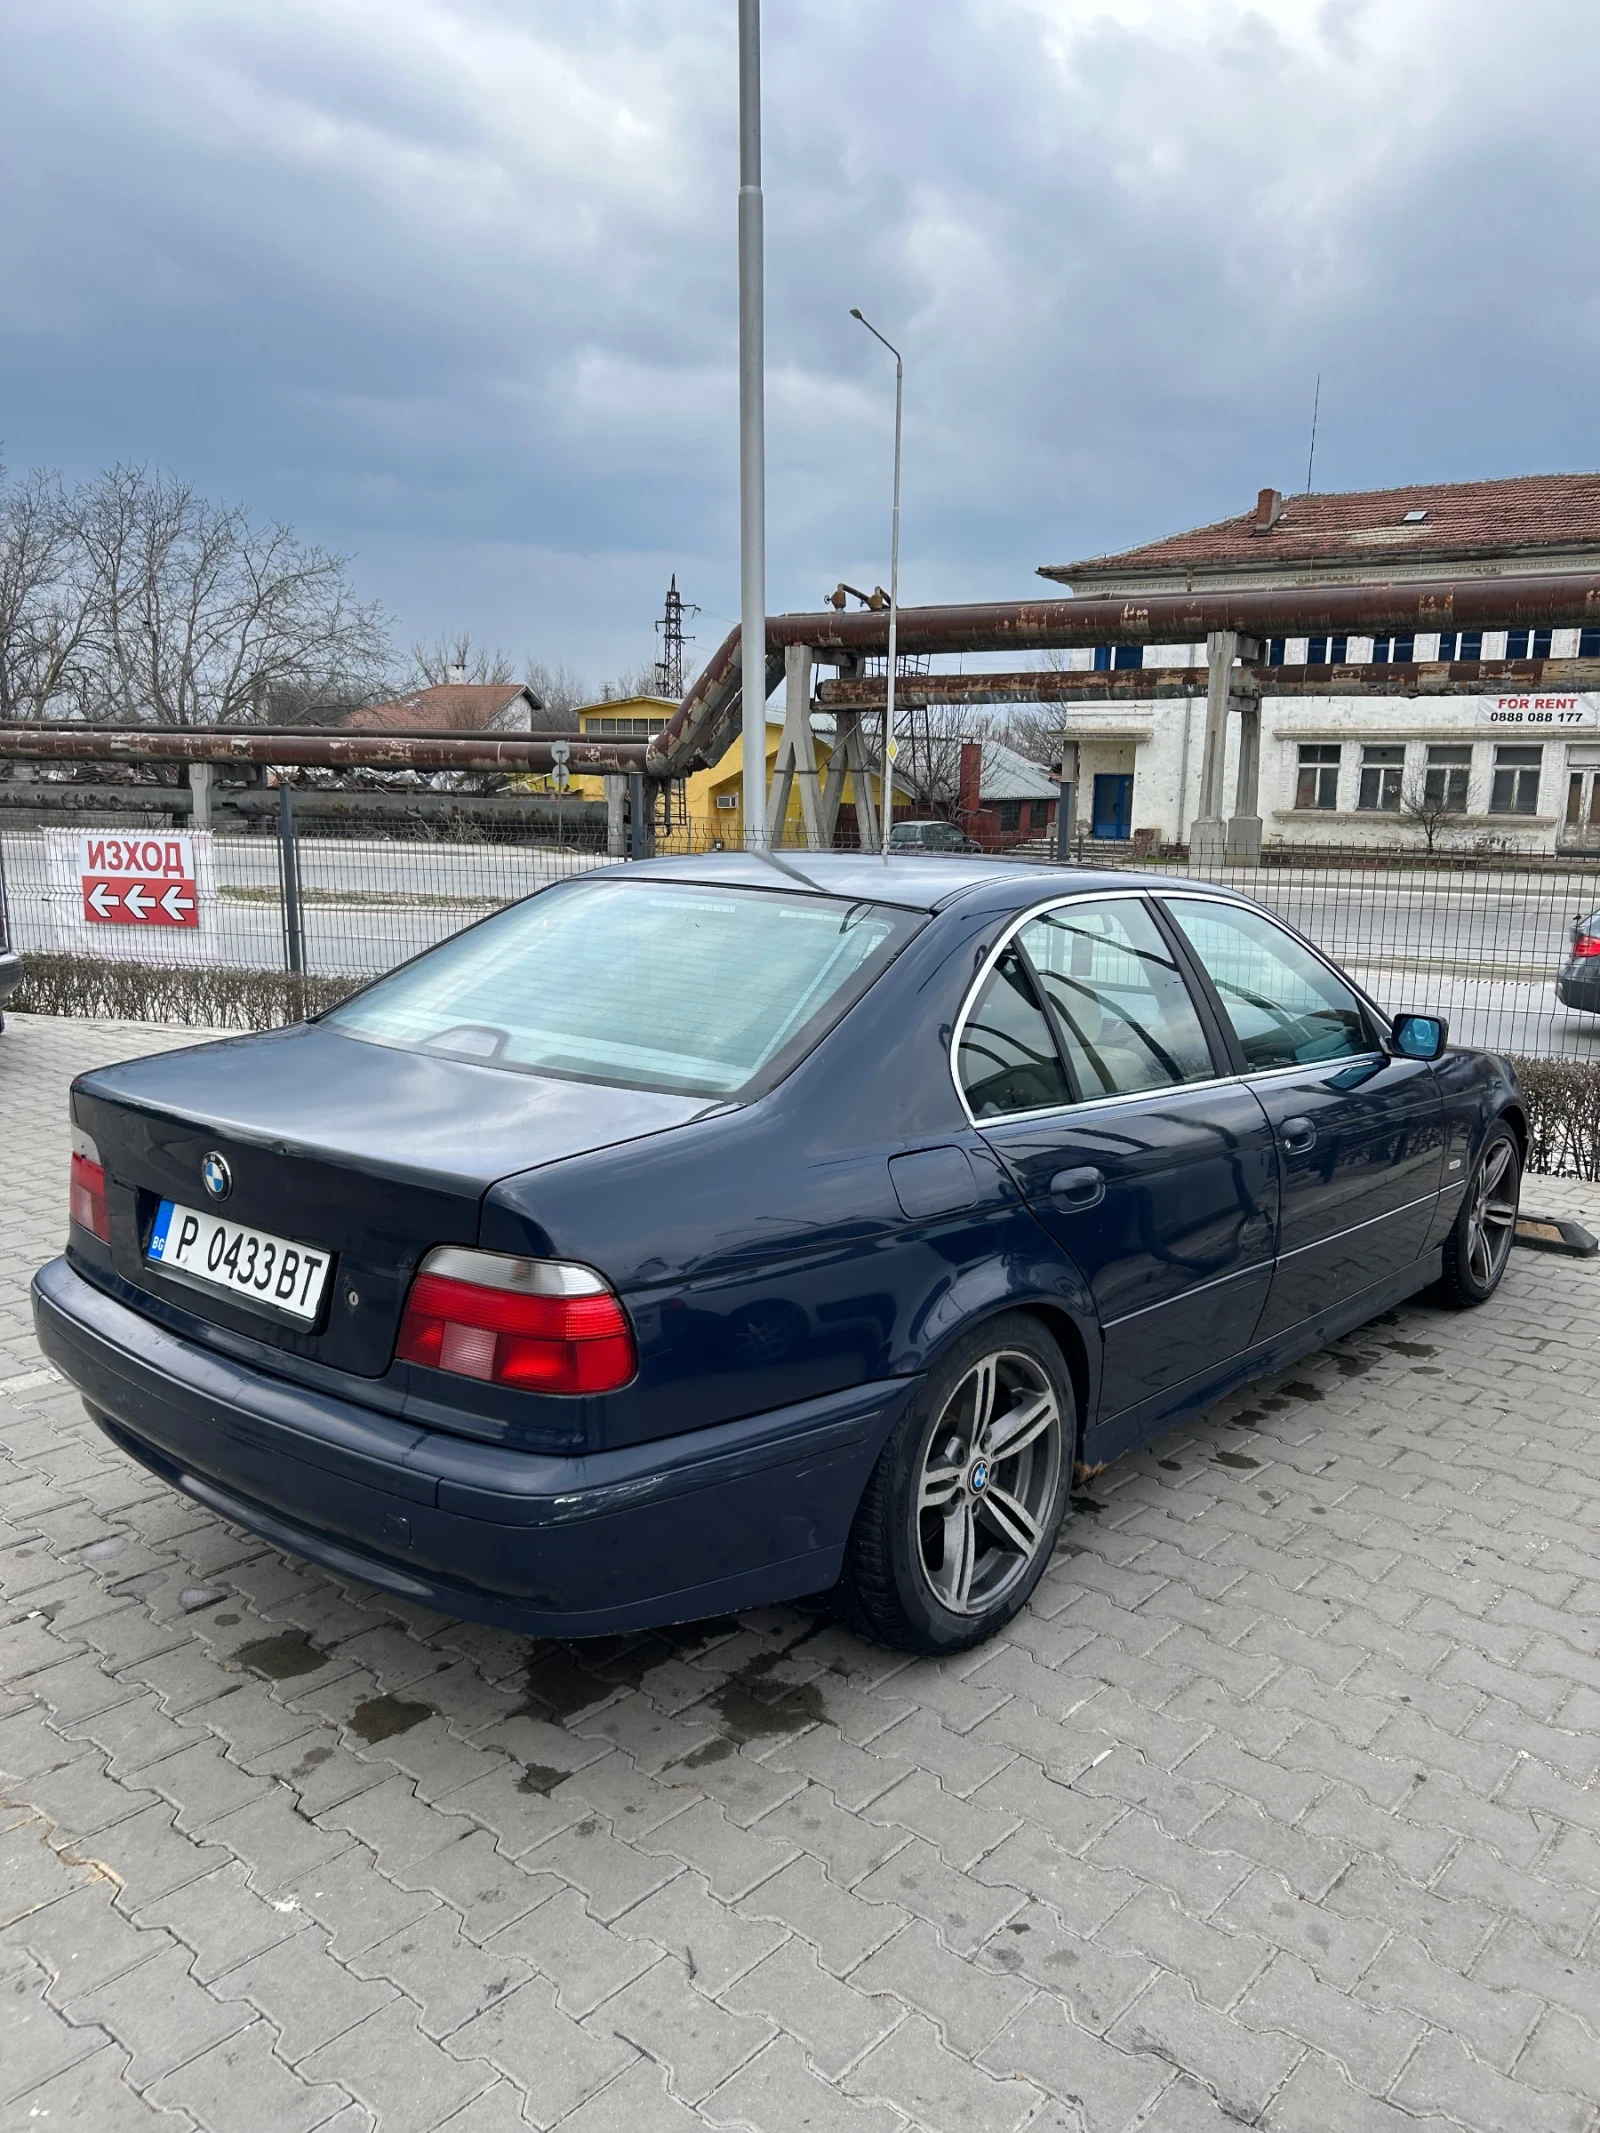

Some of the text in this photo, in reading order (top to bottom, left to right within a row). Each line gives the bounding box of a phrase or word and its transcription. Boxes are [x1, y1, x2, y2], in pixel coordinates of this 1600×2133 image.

[1498, 698, 1578, 709] FOR RENT
[1490, 712, 1583, 722] 0888 088 177
[87, 840, 185, 878] ИЗХОД
[152, 1236, 165, 1251] BG
